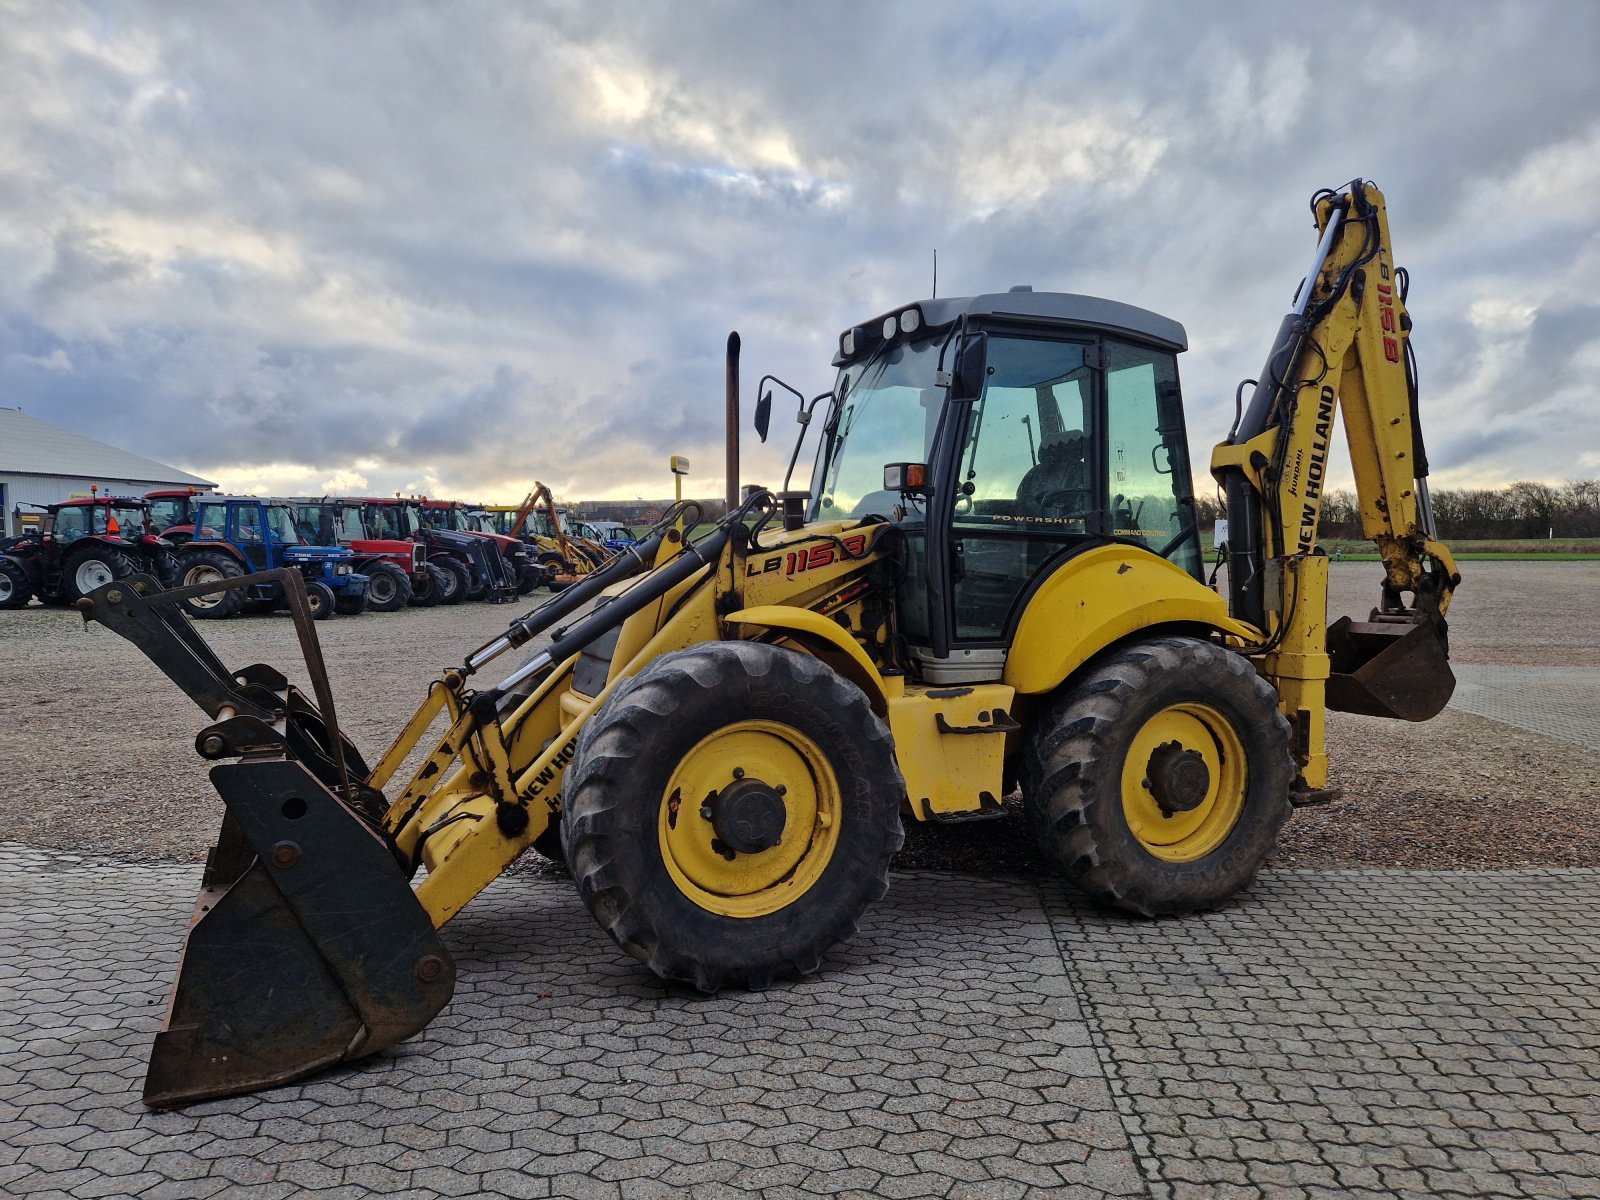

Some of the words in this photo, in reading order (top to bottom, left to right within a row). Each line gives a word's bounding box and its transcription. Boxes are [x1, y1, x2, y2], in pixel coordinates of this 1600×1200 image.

[1306, 385, 1334, 499] HOLLAND
[992, 514, 1085, 525] POWERSHIFT
[518, 766, 555, 807] NEW
